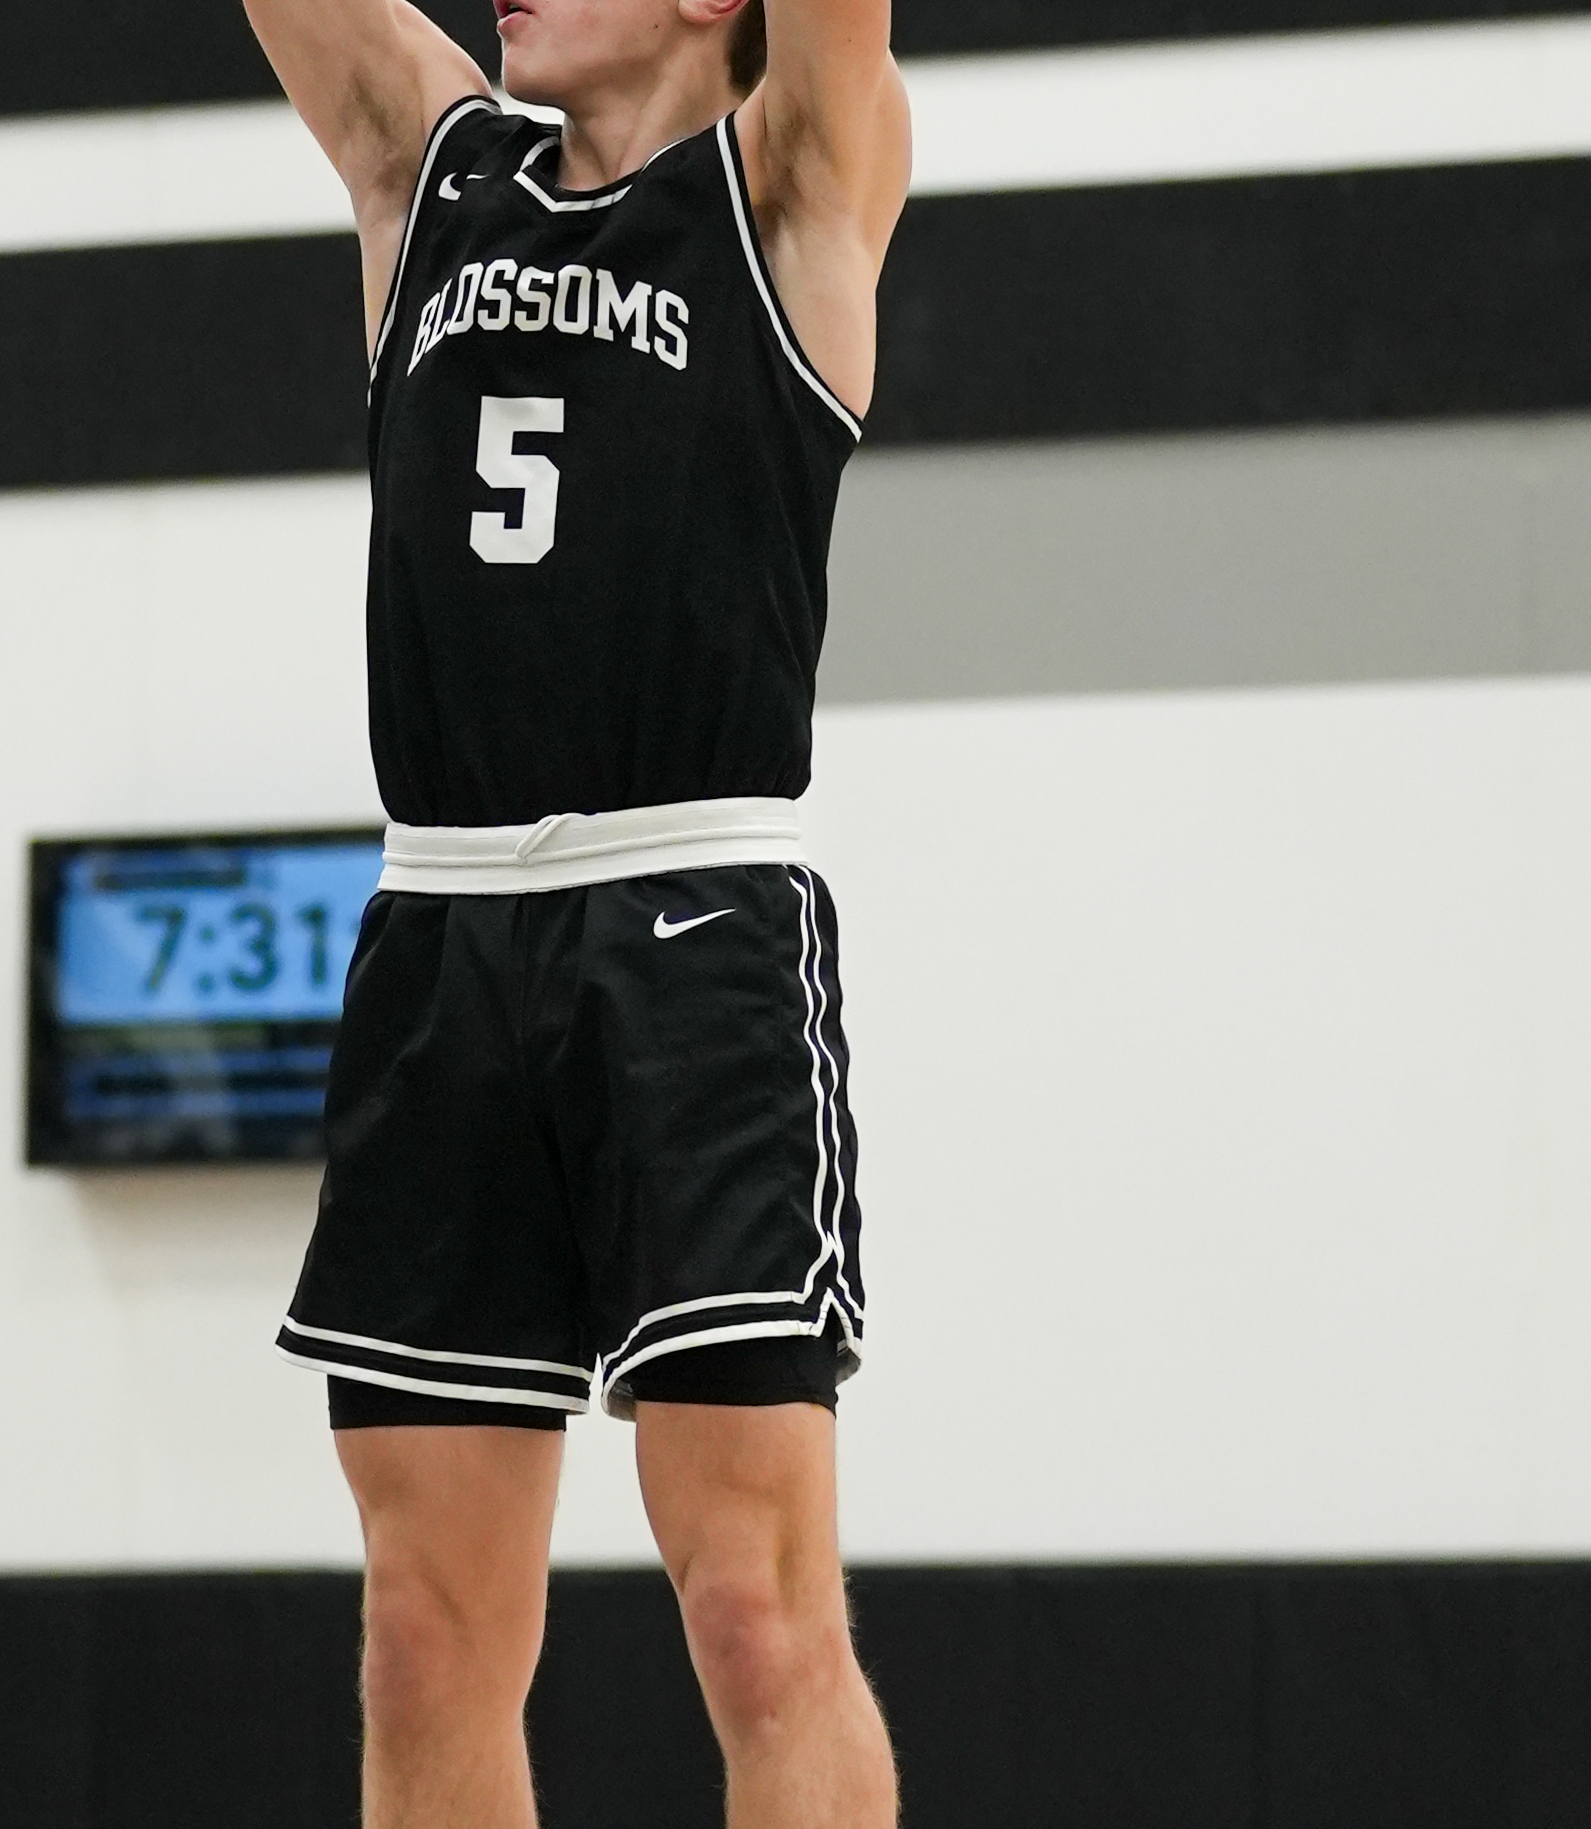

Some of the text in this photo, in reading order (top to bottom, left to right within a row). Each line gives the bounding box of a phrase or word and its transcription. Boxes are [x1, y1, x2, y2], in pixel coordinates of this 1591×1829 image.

[407, 258, 690, 377] BLOSSOMS
[469, 395, 565, 564] 5
[133, 901, 361, 995] 7:31
